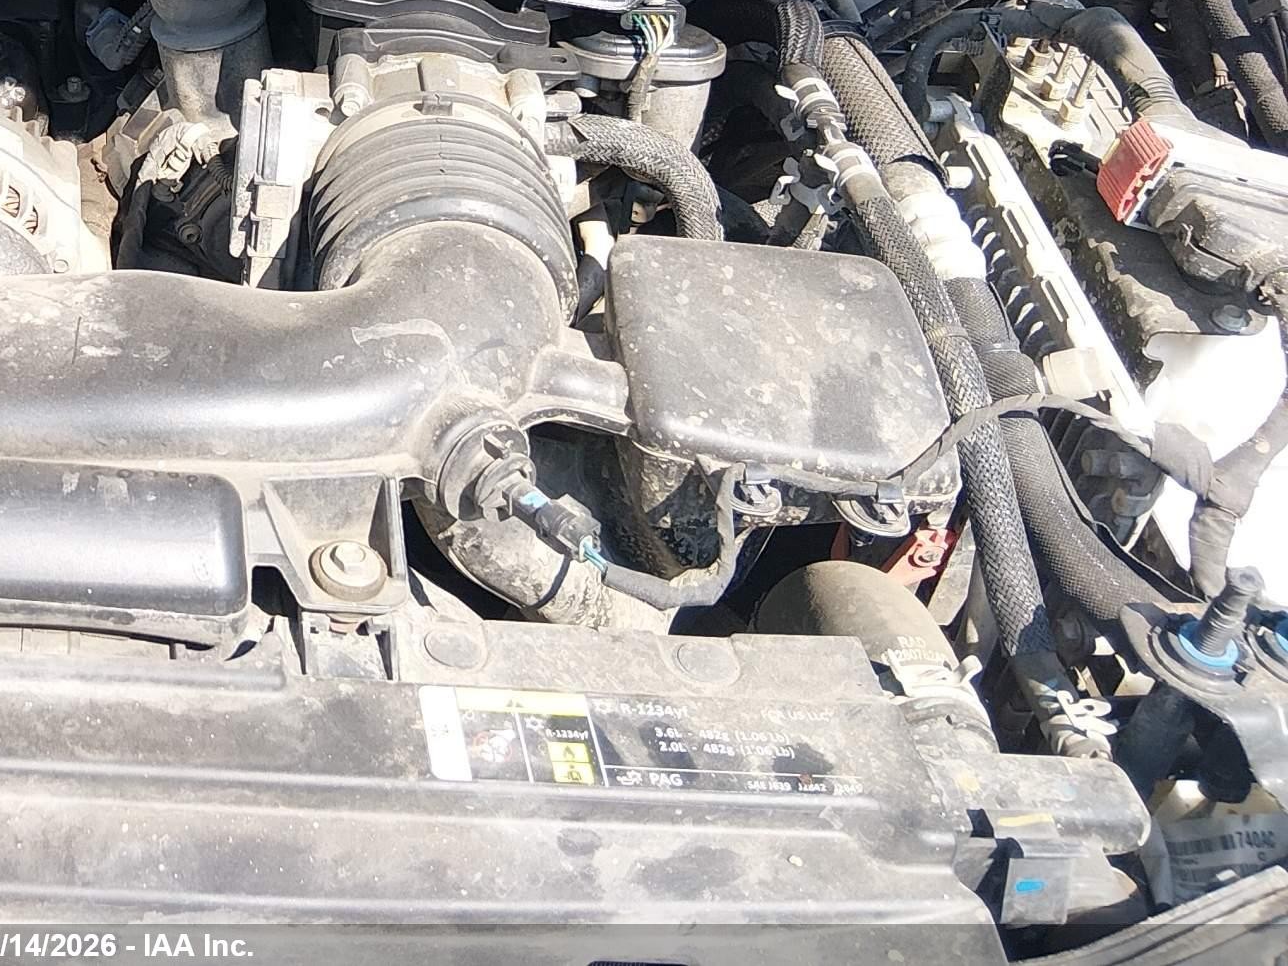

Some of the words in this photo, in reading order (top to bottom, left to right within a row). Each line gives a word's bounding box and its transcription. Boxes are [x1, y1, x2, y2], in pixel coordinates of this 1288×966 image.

[620, 703, 689, 720] R-1234yf
[654, 726, 683, 739] 3.6L
[658, 740, 688, 753] 2.0L
[649, 773, 683, 787] PAG
